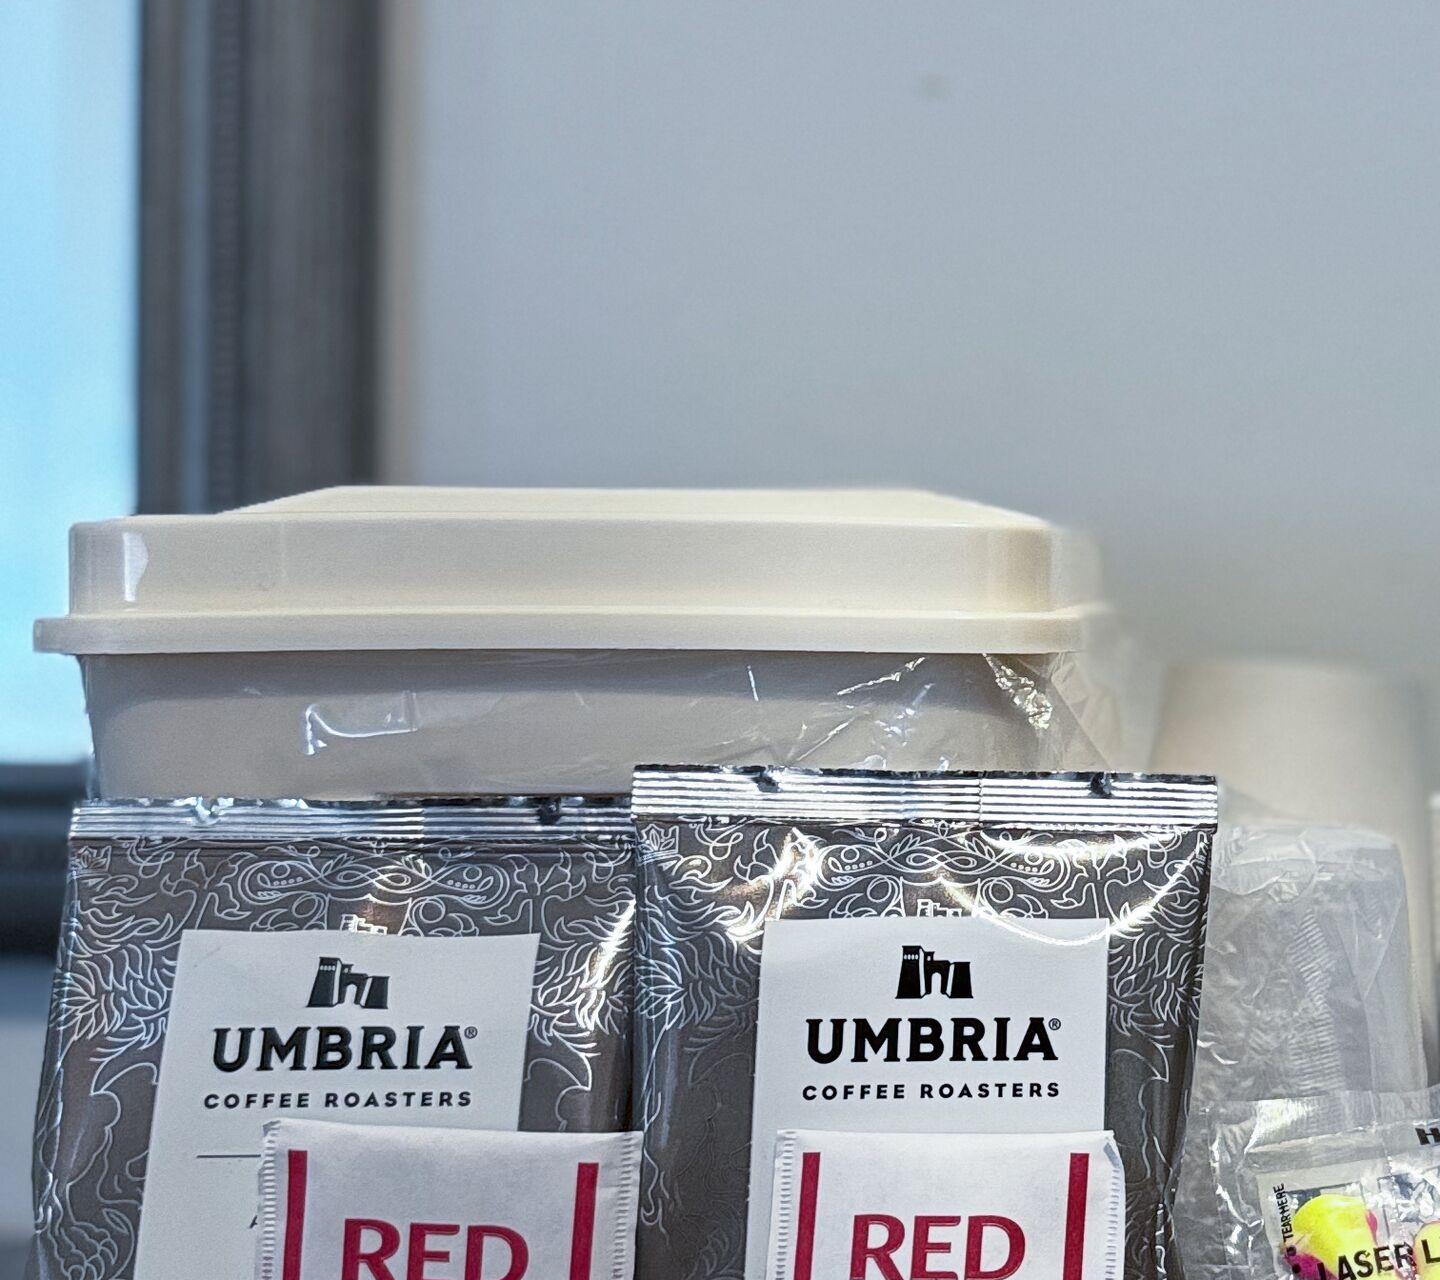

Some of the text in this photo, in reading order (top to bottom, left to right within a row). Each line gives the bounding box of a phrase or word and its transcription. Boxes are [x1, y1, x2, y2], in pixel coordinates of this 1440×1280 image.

[203, 1091, 471, 1109] COFFEE ROASTERS
[802, 1082, 1059, 1100] COFFEE ROASTERS
